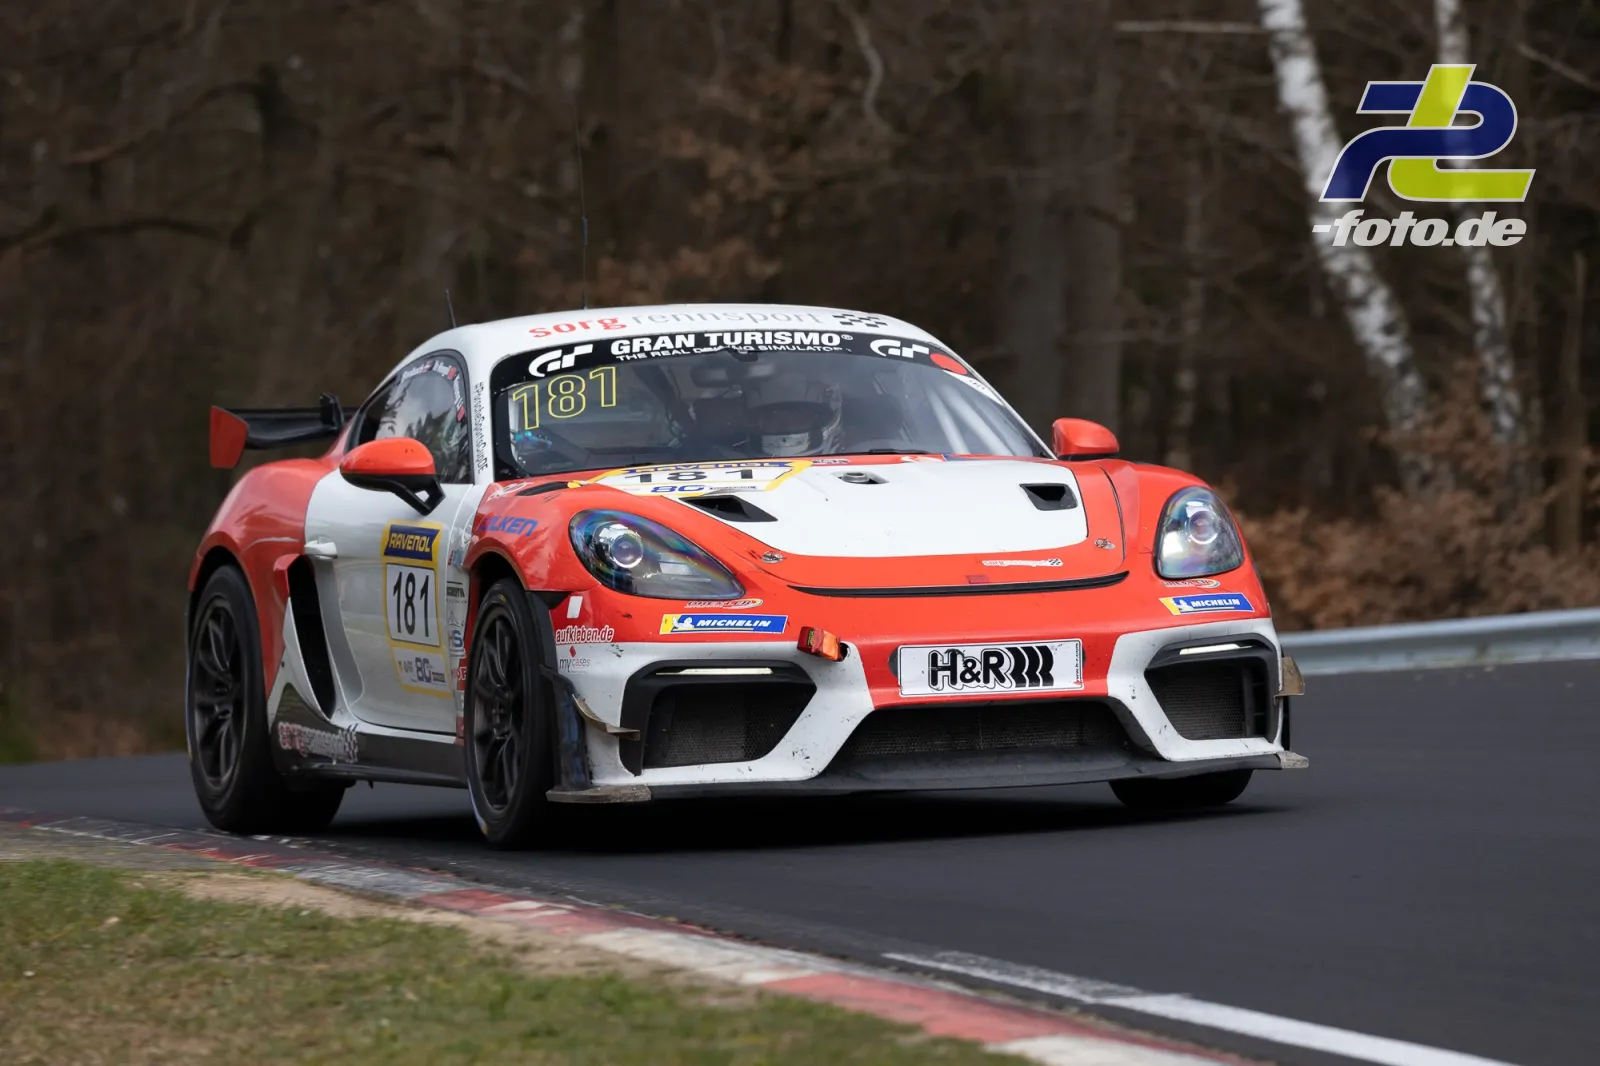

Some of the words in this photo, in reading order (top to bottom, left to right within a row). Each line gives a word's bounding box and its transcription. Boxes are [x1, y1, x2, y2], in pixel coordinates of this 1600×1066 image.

[529, 317, 627, 338] sorg
[632, 312, 825, 326] rennsport
[610, 333, 696, 356] GRAN
[615, 352, 648, 362] THE
[650, 348, 691, 358] REAL
[512, 366, 617, 431] 181
[624, 469, 754, 483] 181
[388, 532, 430, 553] RAVENOL
[393, 571, 430, 638] 181
[1190, 598, 1241, 608] MICHELIN
[696, 619, 772, 628] MICHELIN
[556, 625, 615, 644] aufkleben.de
[928, 648, 1013, 691] H&R
